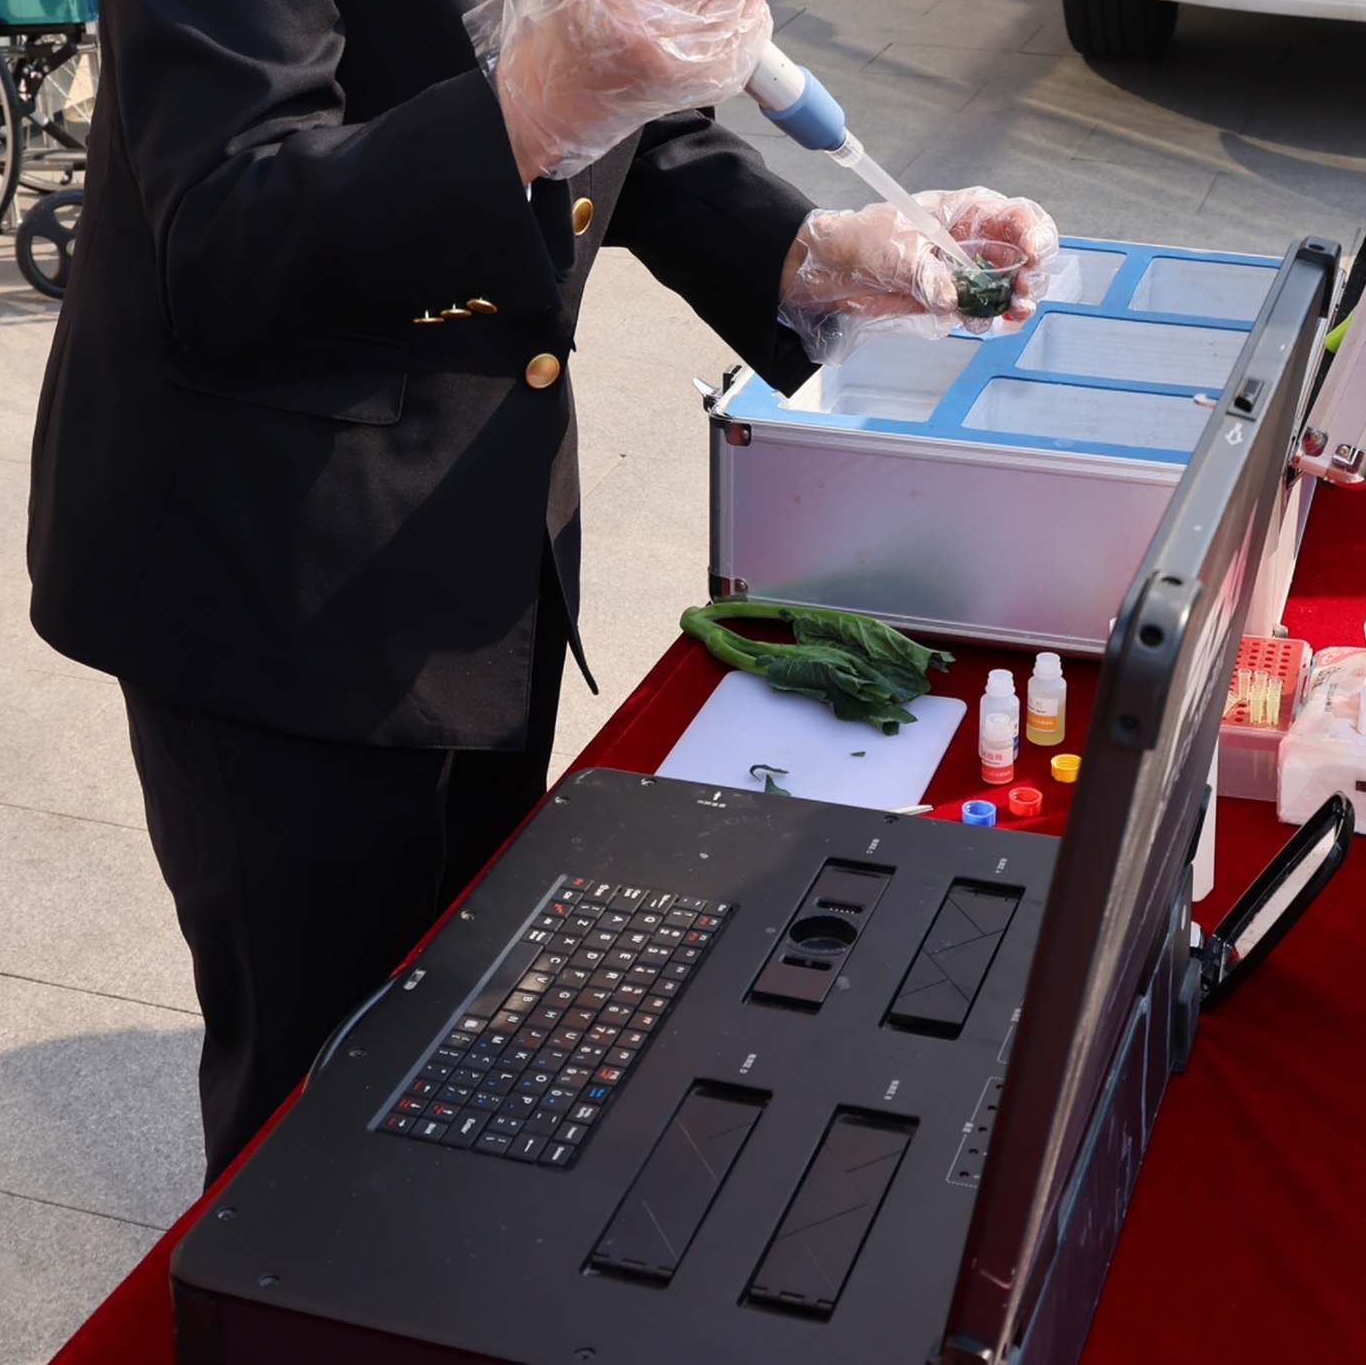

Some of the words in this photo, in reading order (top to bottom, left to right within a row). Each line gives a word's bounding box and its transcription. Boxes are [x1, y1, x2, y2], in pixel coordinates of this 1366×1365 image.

[577, 919, 588, 927] Z
[631, 935, 644, 943] W
[574, 971, 585, 979] F
[606, 972, 618, 980] R
[507, 1015, 519, 1023] N
[491, 1035, 504, 1044] M
[565, 1032, 578, 1040] U
[515, 1052, 528, 1060] K
[522, 1096, 532, 1105] P
